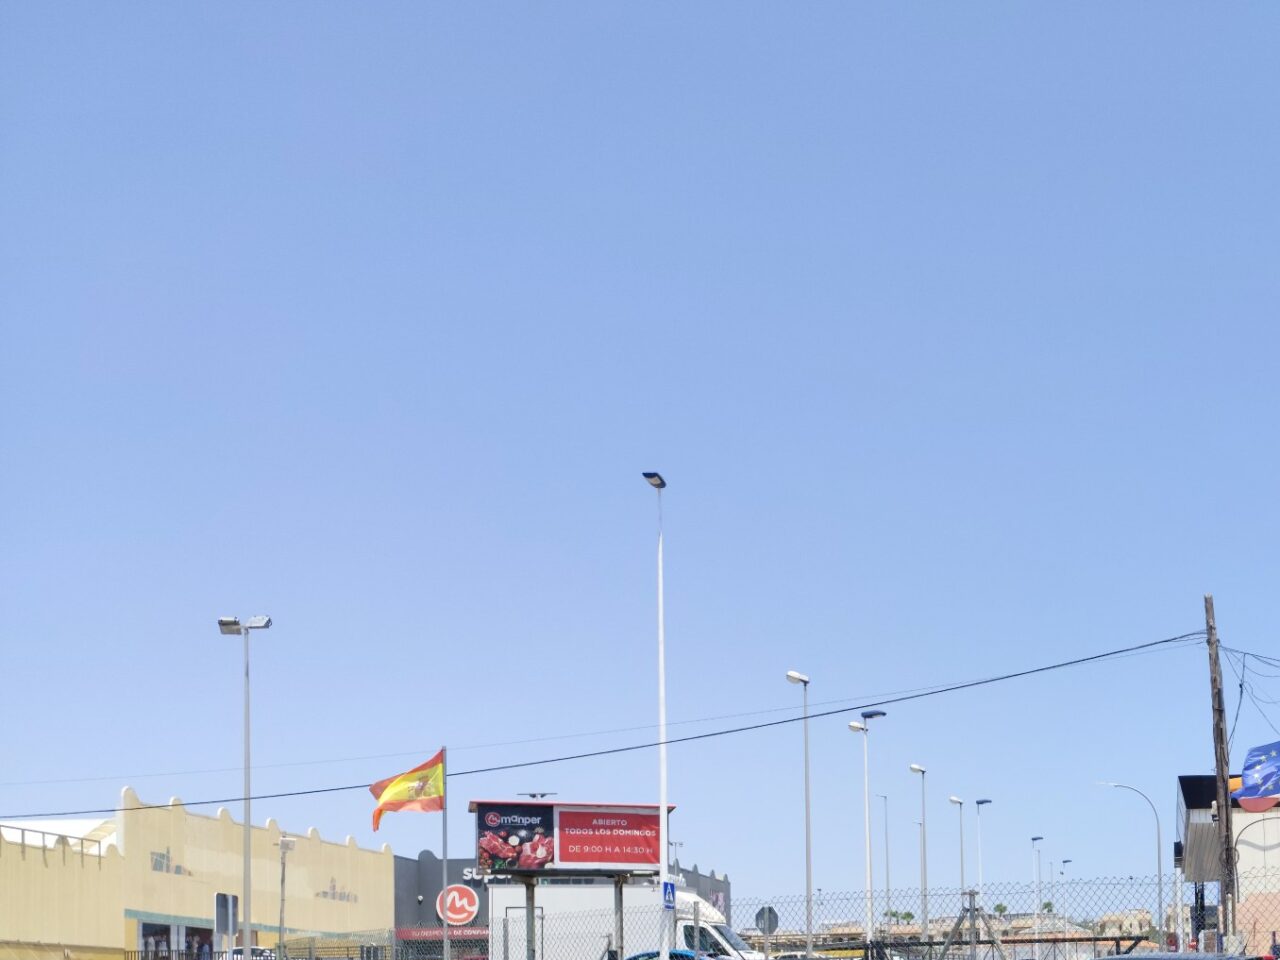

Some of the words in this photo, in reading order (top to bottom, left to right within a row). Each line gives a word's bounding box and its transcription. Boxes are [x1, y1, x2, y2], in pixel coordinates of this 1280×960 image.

[500, 815, 541, 826] manper
[569, 845, 581, 853] DE
[583, 845, 603, 853] 9:00
[623, 846, 645, 854] 14:30
[463, 867, 512, 883] sup
